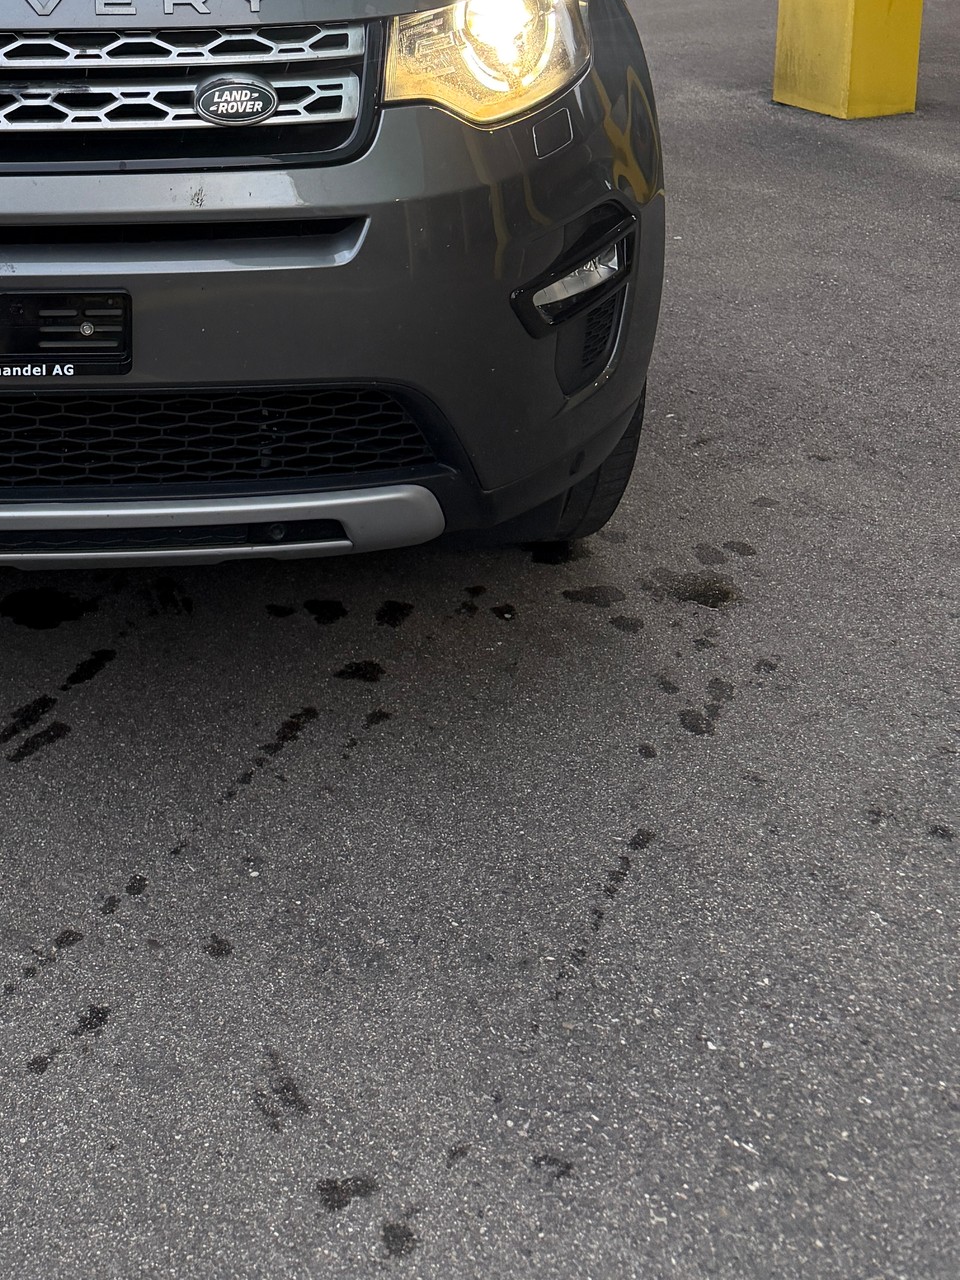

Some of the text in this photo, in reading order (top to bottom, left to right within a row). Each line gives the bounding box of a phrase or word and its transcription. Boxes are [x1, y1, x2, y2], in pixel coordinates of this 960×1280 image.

[213, 90, 251, 102] LAND
[217, 101, 263, 114] ROVER
[52, 364, 75, 376] AG
